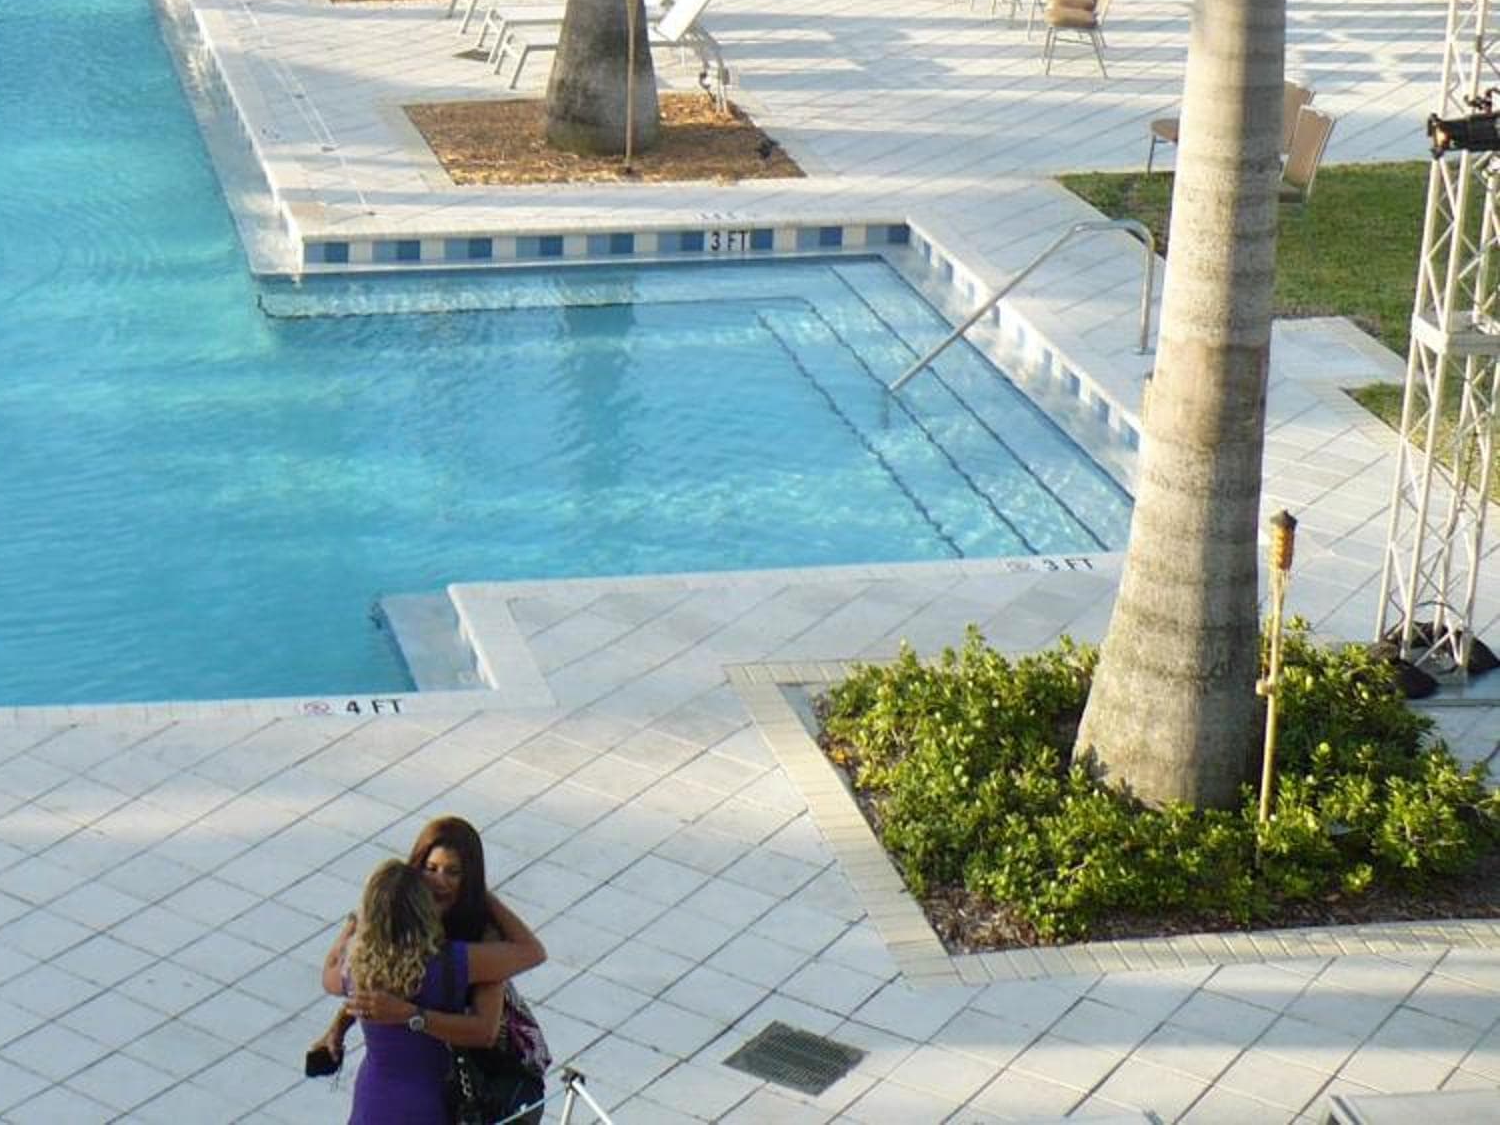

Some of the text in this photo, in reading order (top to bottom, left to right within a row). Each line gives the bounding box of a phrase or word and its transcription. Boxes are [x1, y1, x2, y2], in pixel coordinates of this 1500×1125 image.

[711, 229, 749, 252] 3 FT
[347, 698, 402, 715] 4 FT
